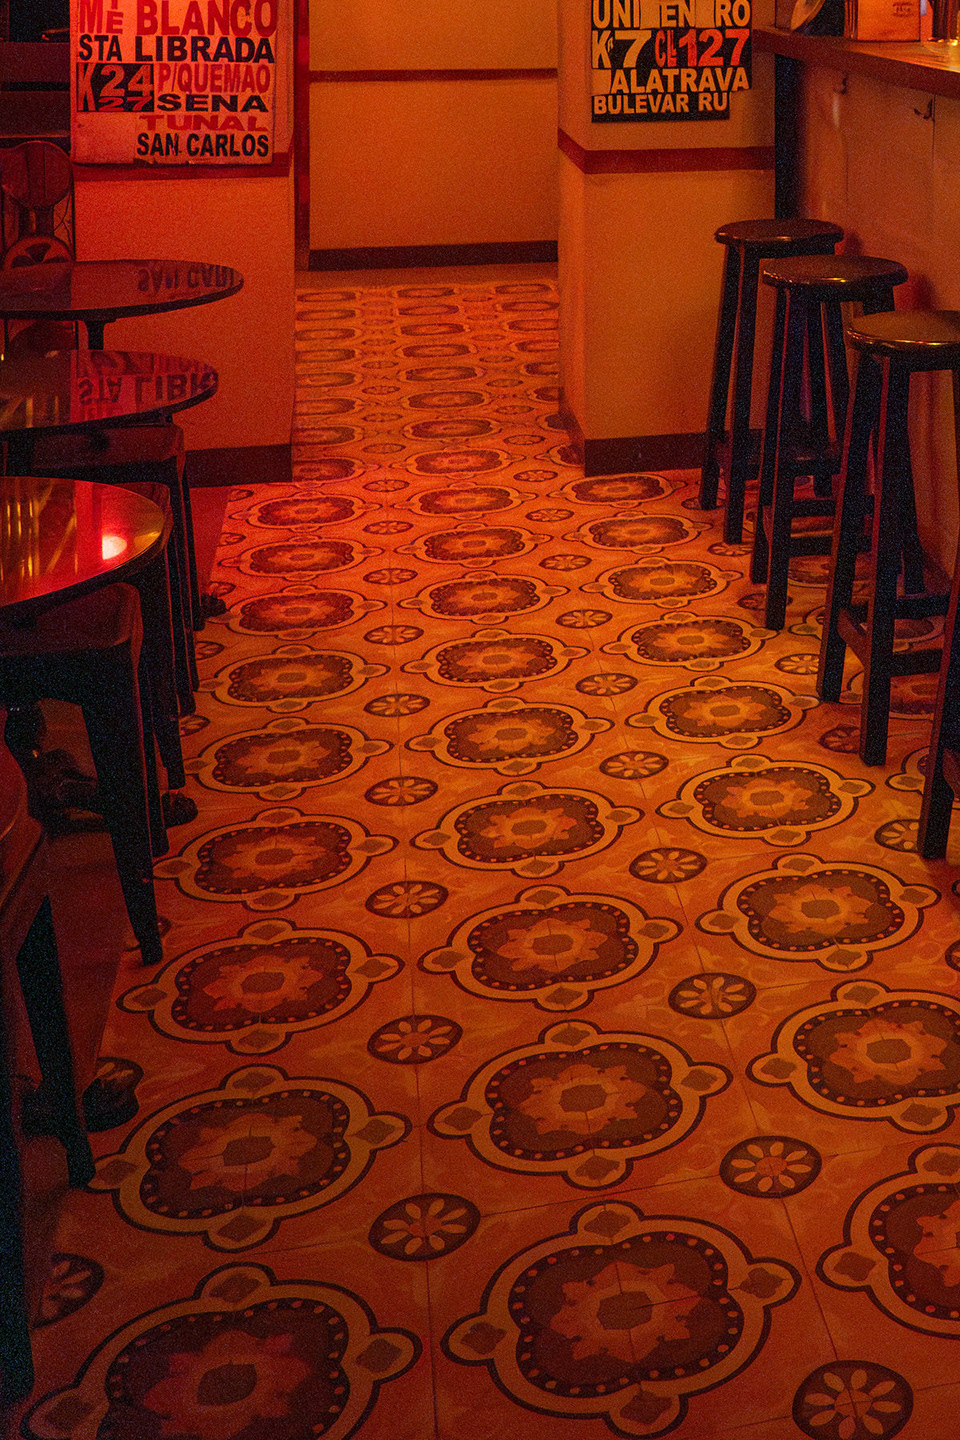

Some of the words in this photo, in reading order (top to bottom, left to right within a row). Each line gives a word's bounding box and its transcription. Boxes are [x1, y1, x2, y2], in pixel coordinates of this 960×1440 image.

[78, 34, 123, 62] STA
[134, 36, 275, 63] LIBRADA
[614, 30, 652, 68] 7
[678, 28, 750, 67] 127
[100, 64, 154, 98] 24
[611, 67, 750, 94] ALATRAVA
[98, 96, 153, 112] 27
[156, 93, 269, 112] SENA
[593, 93, 690, 115] BULEVAR
[697, 92, 728, 111] RU
[138, 114, 269, 132] TUNAL
[137, 133, 179, 156] SAN
[186, 133, 269, 157] CARLOS
